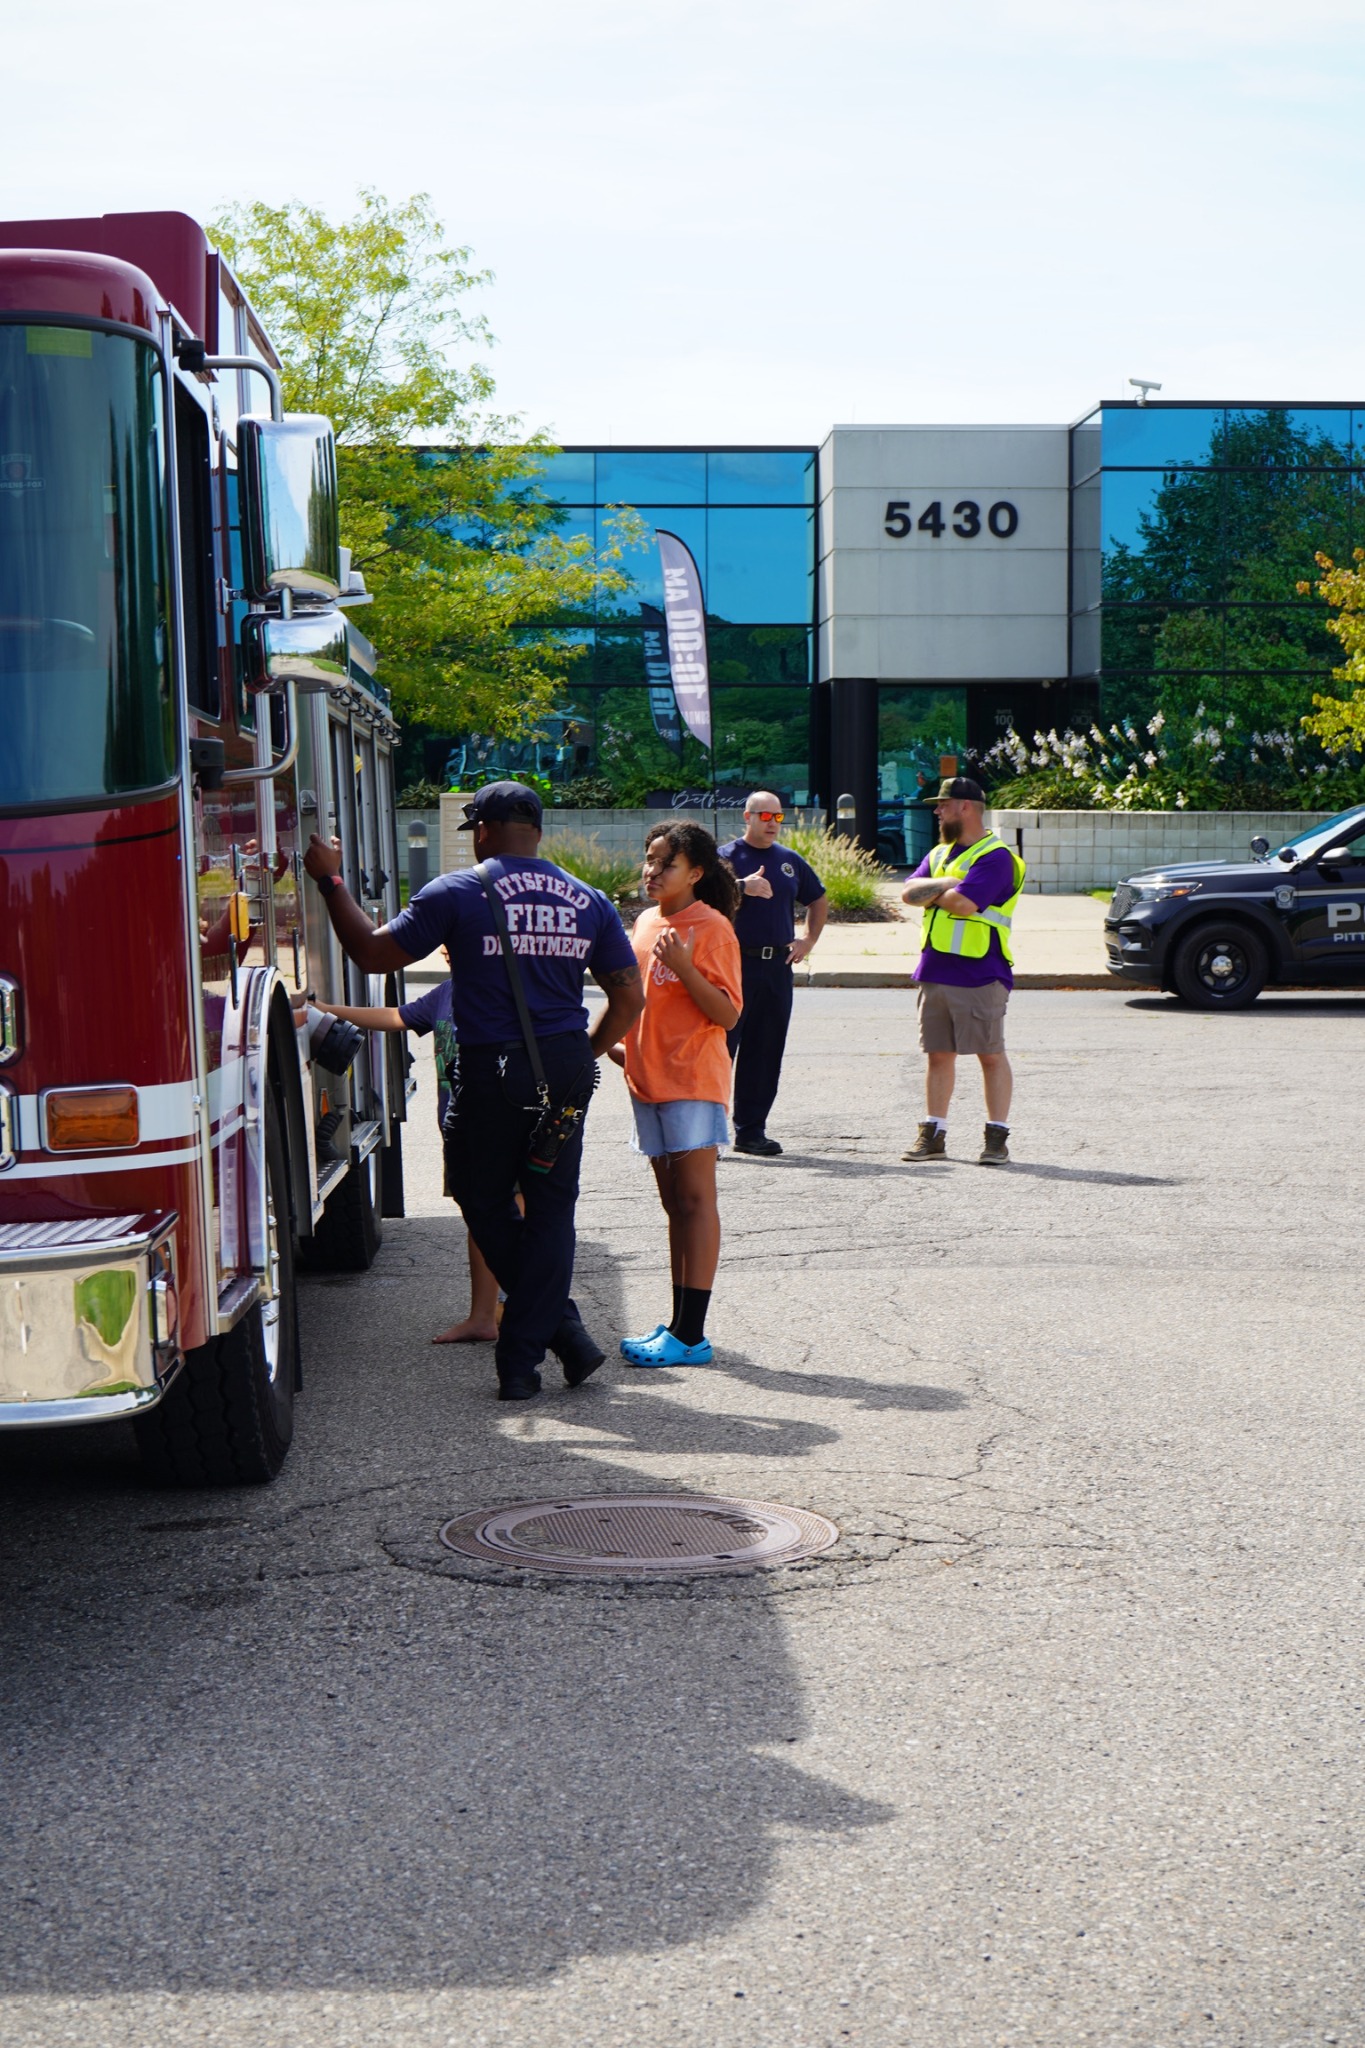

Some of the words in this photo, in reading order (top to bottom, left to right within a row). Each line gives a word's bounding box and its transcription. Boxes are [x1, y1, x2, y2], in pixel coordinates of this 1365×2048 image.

[884, 500, 1019, 538] 5430
[994, 714, 1014, 726] 100
[481, 872, 591, 910] ITTSFIELD
[504, 903, 577, 934] FIRE
[1327, 902, 1365, 928] P
